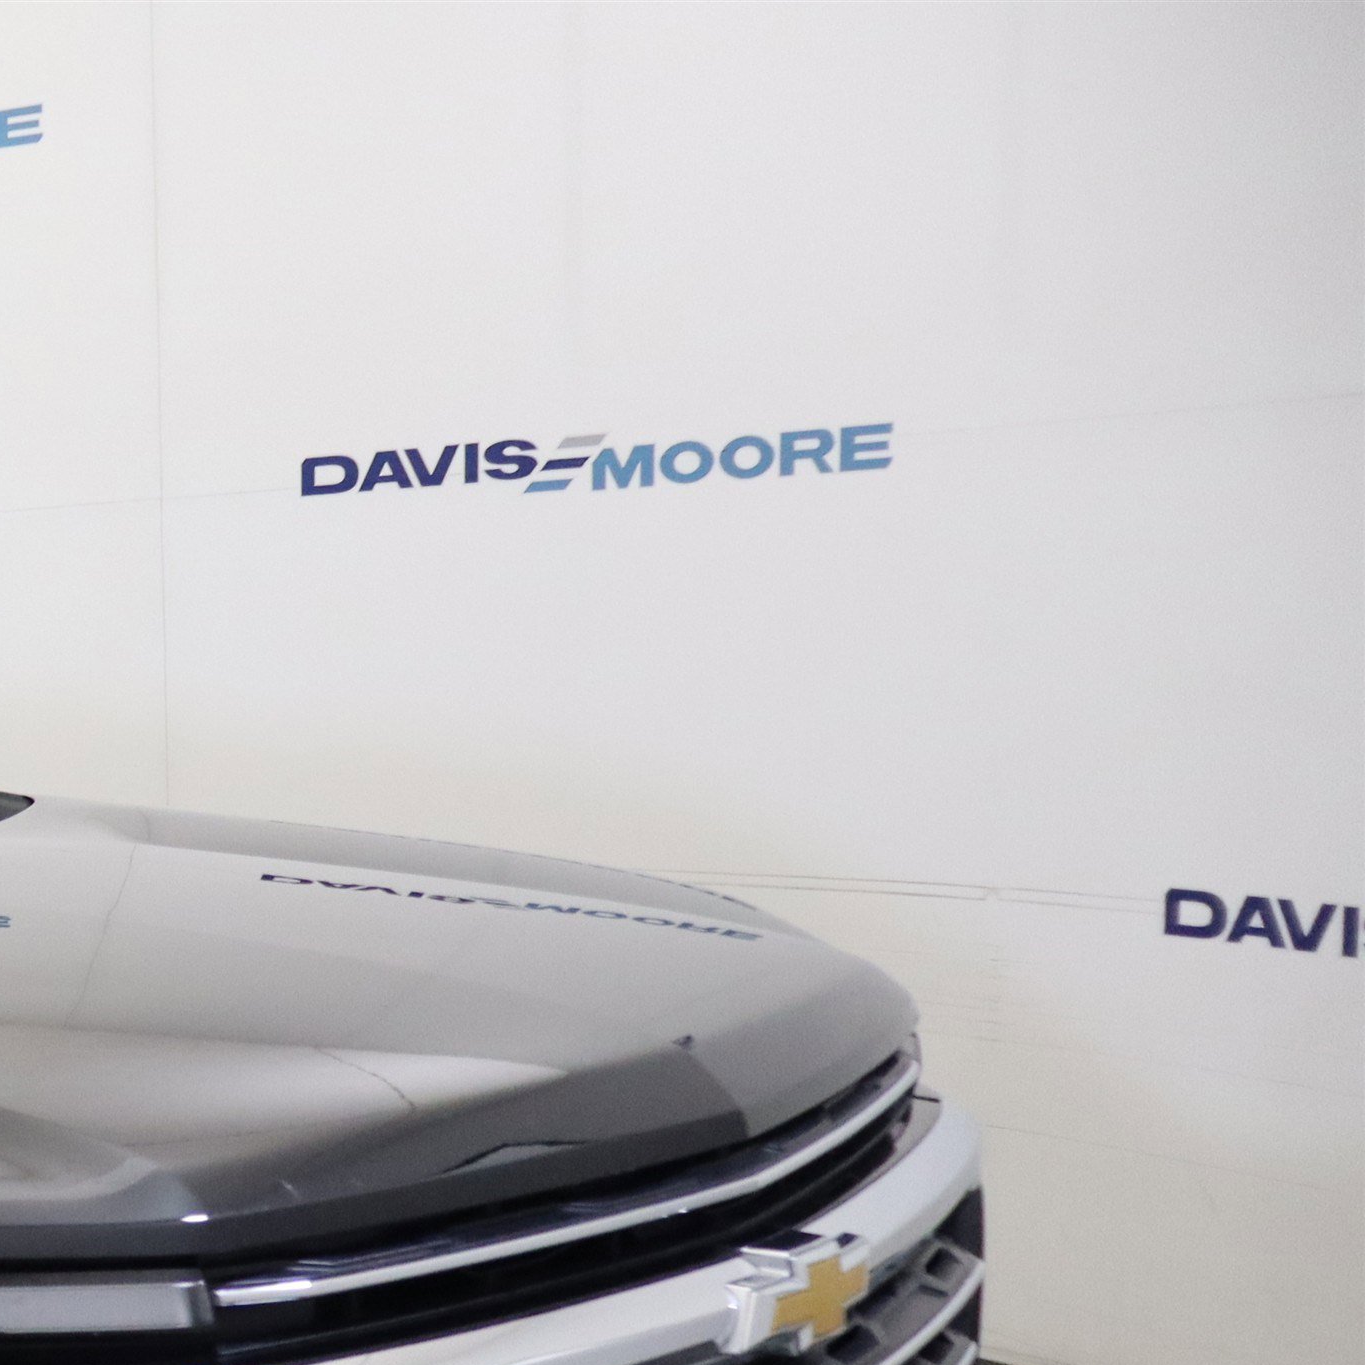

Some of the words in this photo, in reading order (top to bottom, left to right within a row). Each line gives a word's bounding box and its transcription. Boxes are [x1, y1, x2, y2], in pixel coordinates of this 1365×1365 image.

[300, 438, 539, 498] DAVIS
[590, 422, 895, 492] MOORE
[1164, 888, 1365, 958] DAVI
